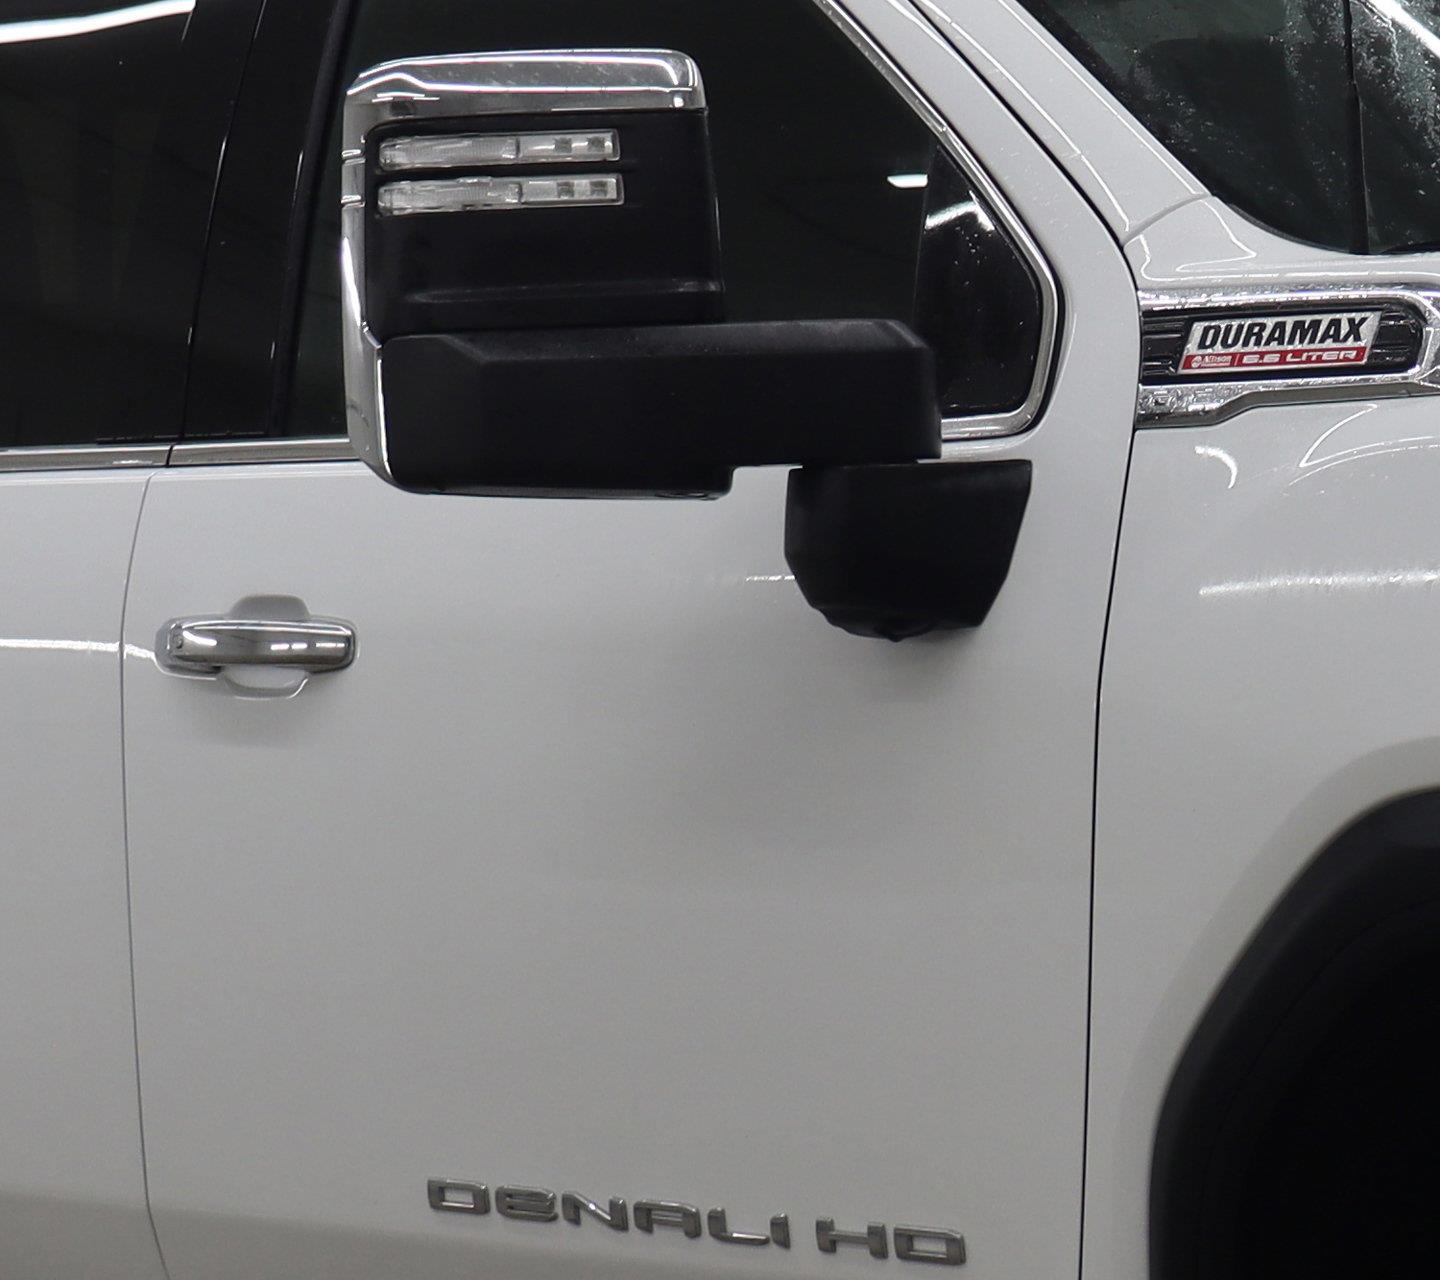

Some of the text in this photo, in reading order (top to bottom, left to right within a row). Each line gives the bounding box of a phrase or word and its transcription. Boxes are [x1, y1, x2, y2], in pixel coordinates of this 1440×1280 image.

[1199, 317, 1367, 350] DURAMAX
[1286, 349, 1358, 361] LITER
[426, 1176, 966, 1266] DENALI HD
